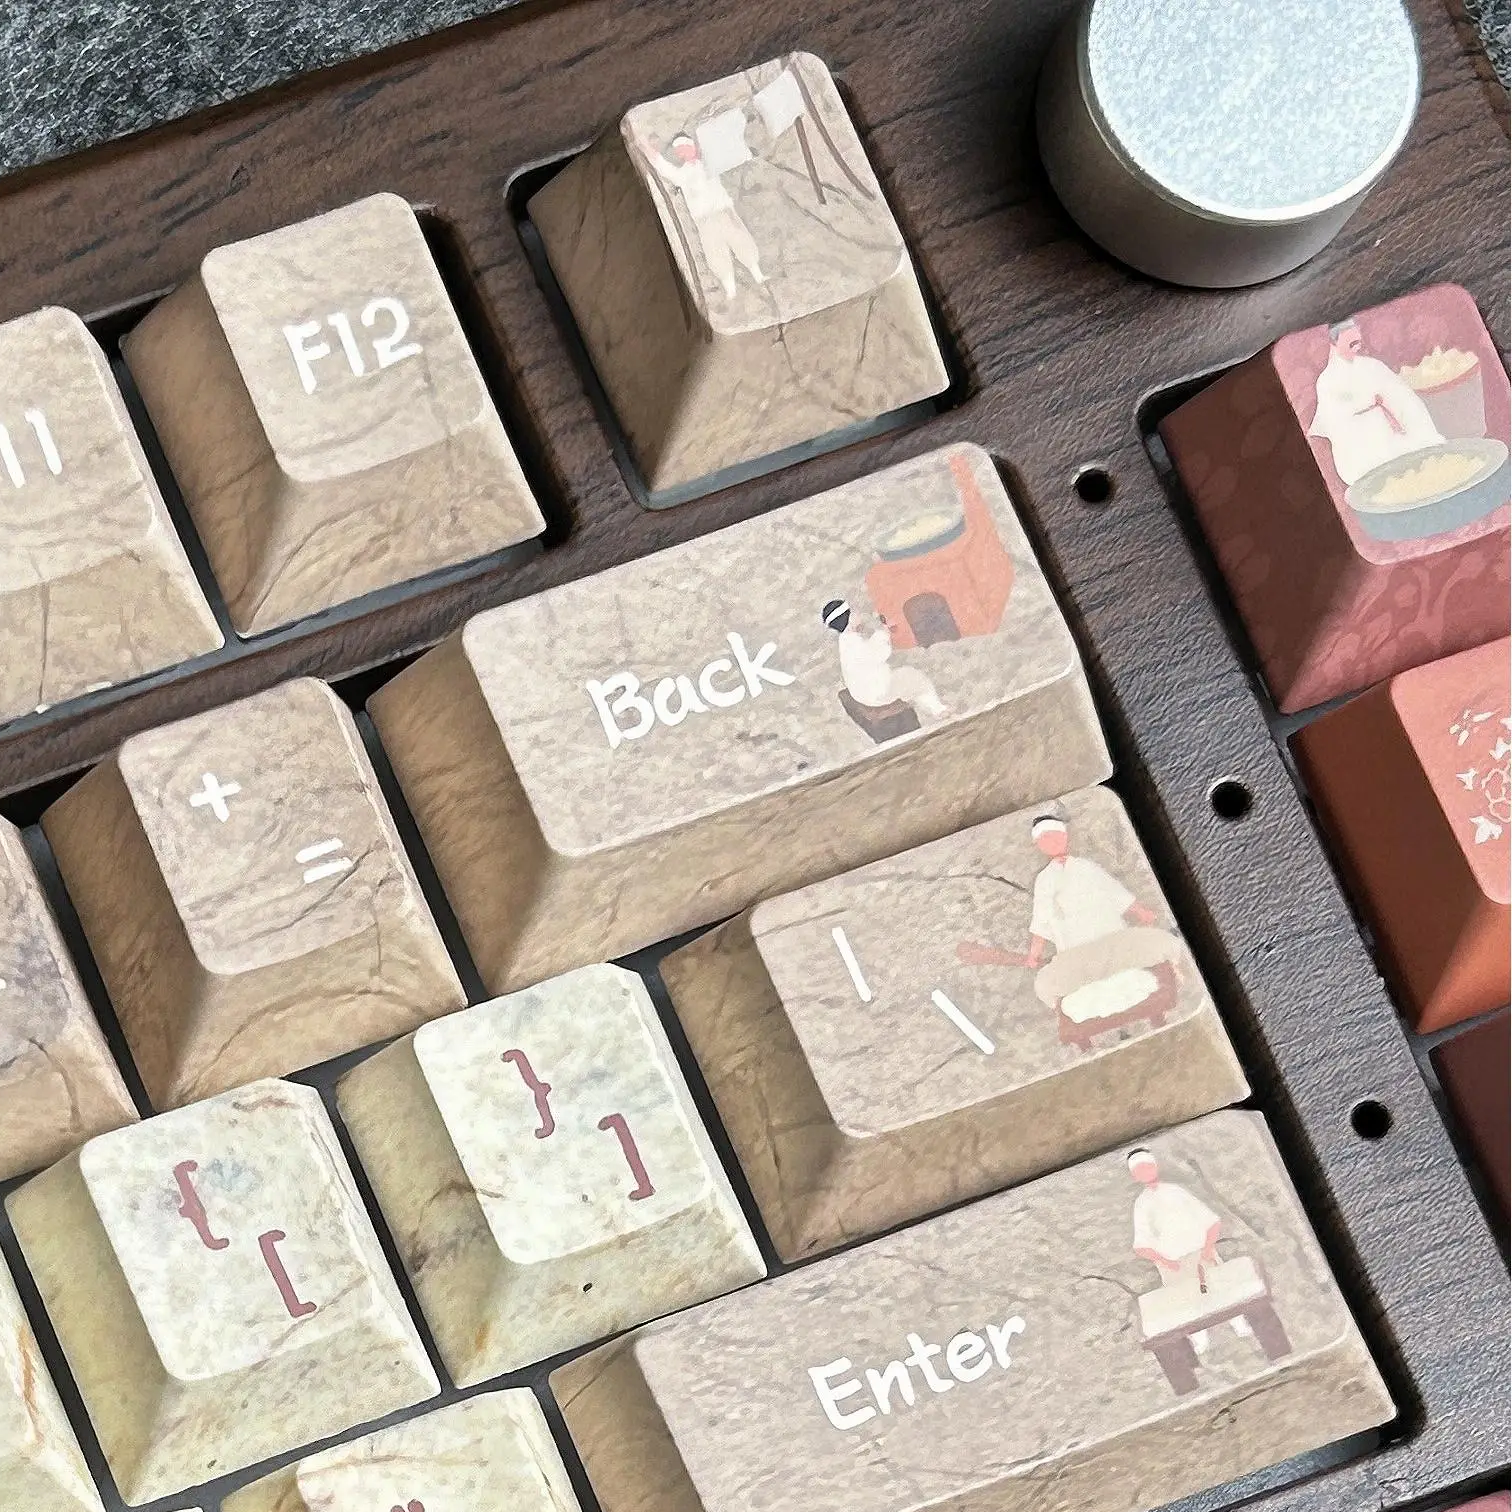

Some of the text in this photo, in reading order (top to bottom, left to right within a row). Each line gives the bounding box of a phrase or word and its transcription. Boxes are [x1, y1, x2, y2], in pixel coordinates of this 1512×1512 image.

[283, 297, 422, 395] F12
[586, 632, 796, 750] Back
[189, 771, 241, 823] +
[295, 838, 353, 883] =
[501, 1048, 553, 1138] }
[598, 1113, 655, 1200] ]
[172, 1159, 230, 1250] {
[259, 1229, 317, 1318] [
[807, 1315, 1025, 1432] Enter
